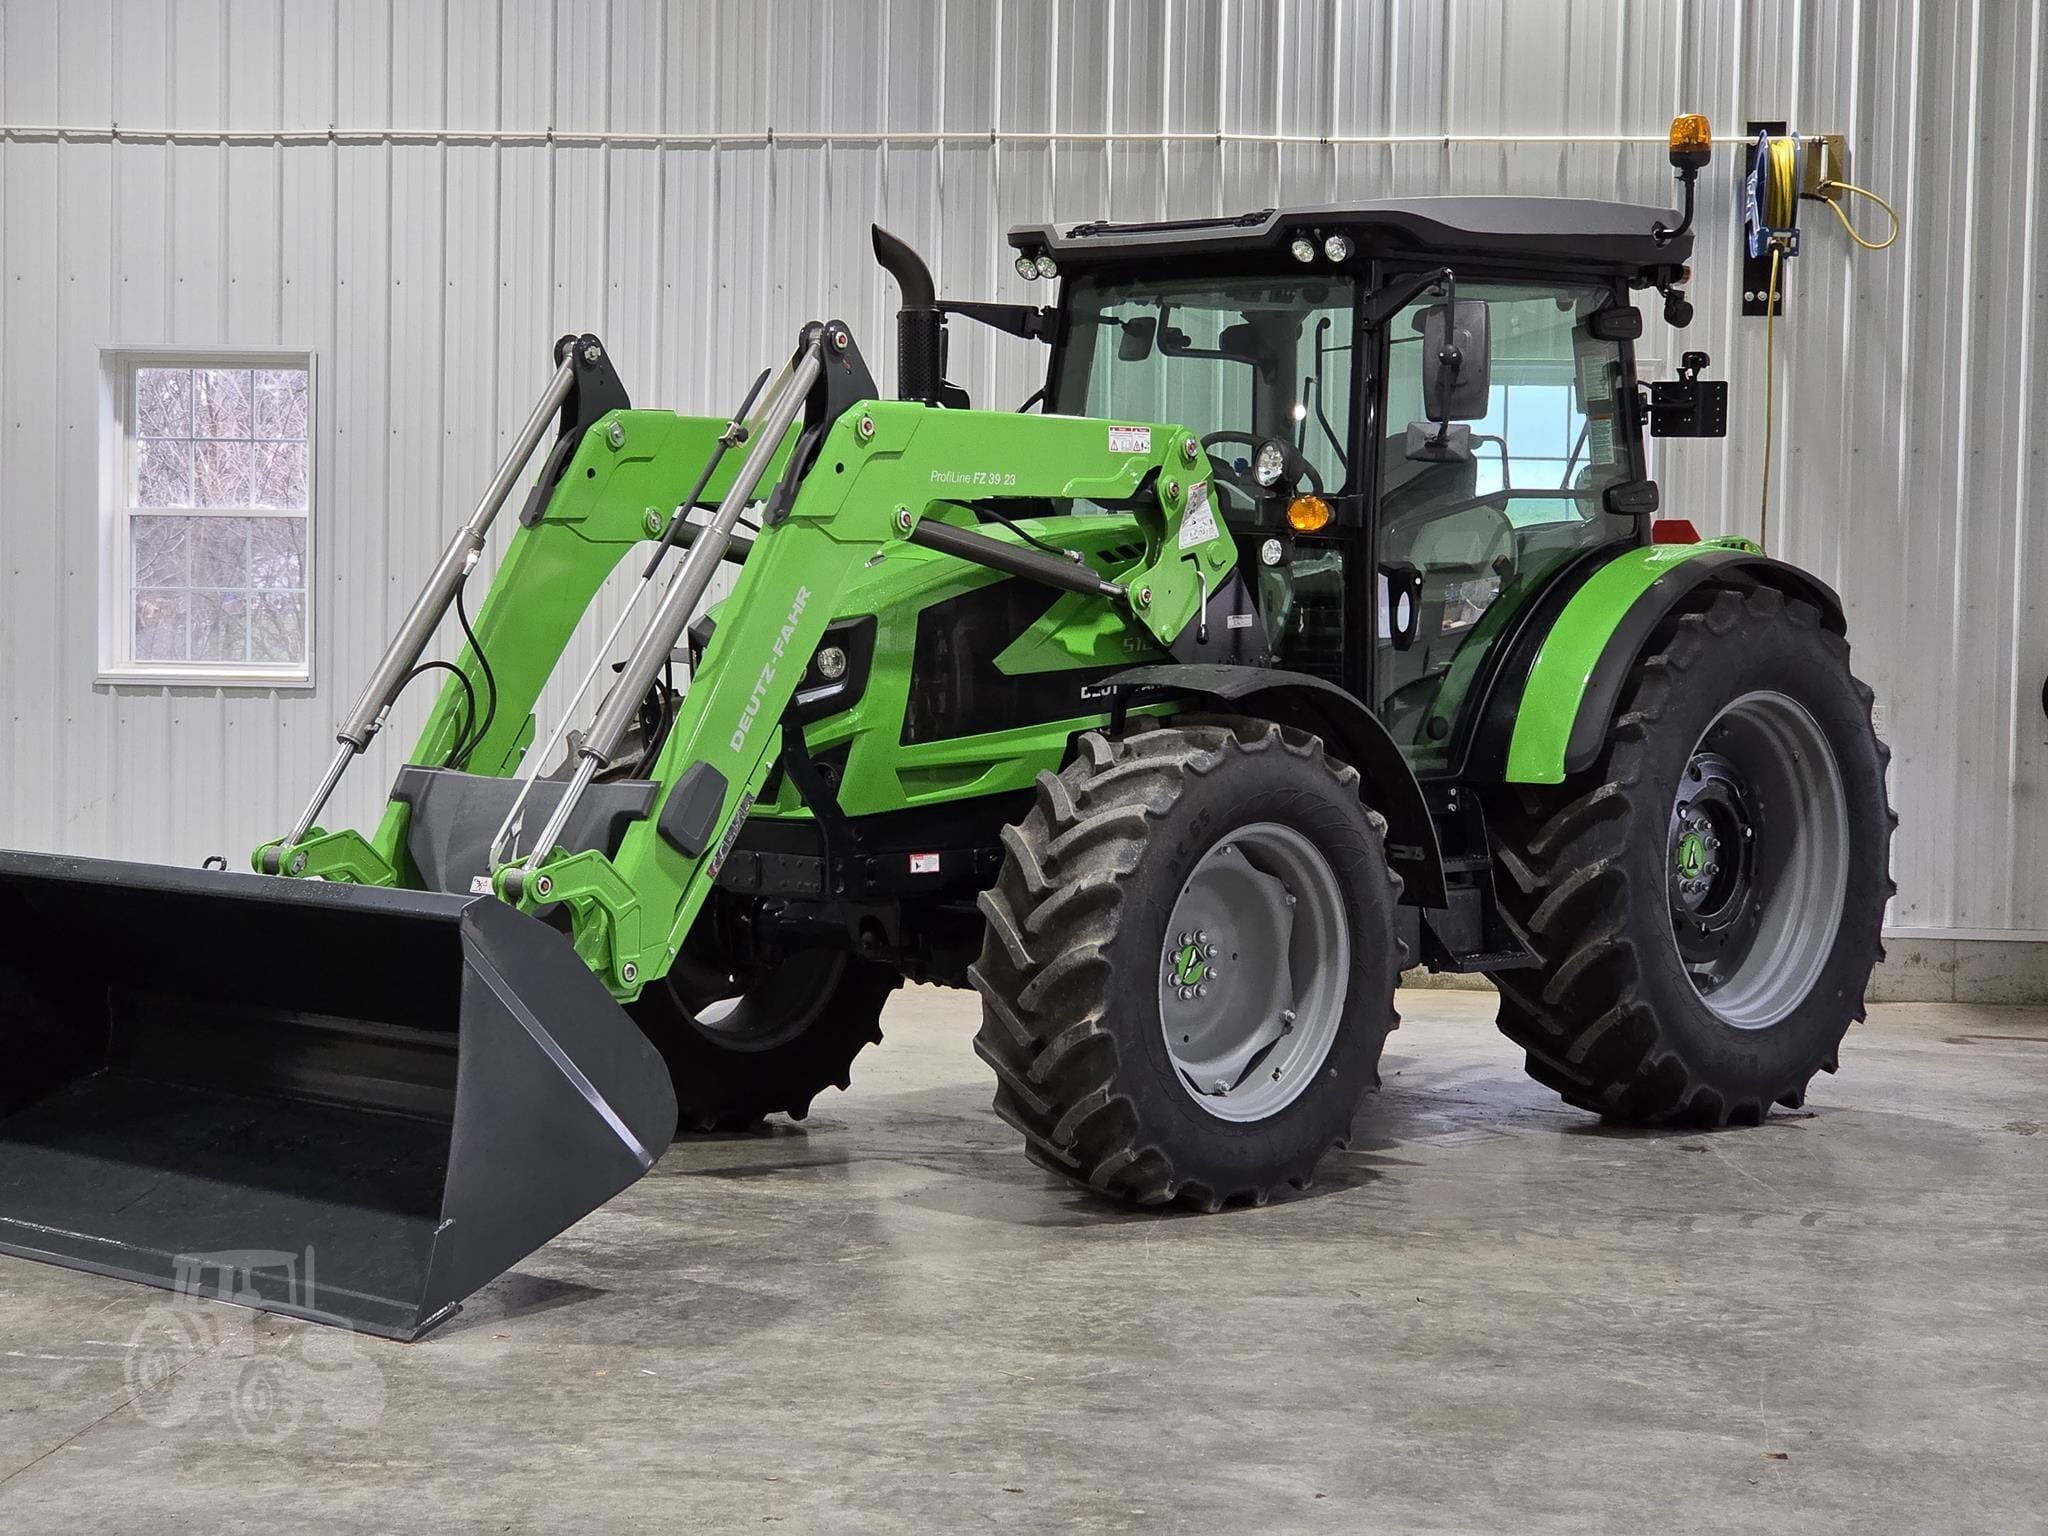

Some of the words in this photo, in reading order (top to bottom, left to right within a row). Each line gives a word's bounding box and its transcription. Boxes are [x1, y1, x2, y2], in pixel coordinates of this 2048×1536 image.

[930, 470, 971, 485] ProfiLine
[973, 472, 987, 485] FZ
[988, 473, 1001, 486] 39
[1003, 473, 1017, 487] 23
[729, 585, 812, 753] DEUTZ-FAHR
